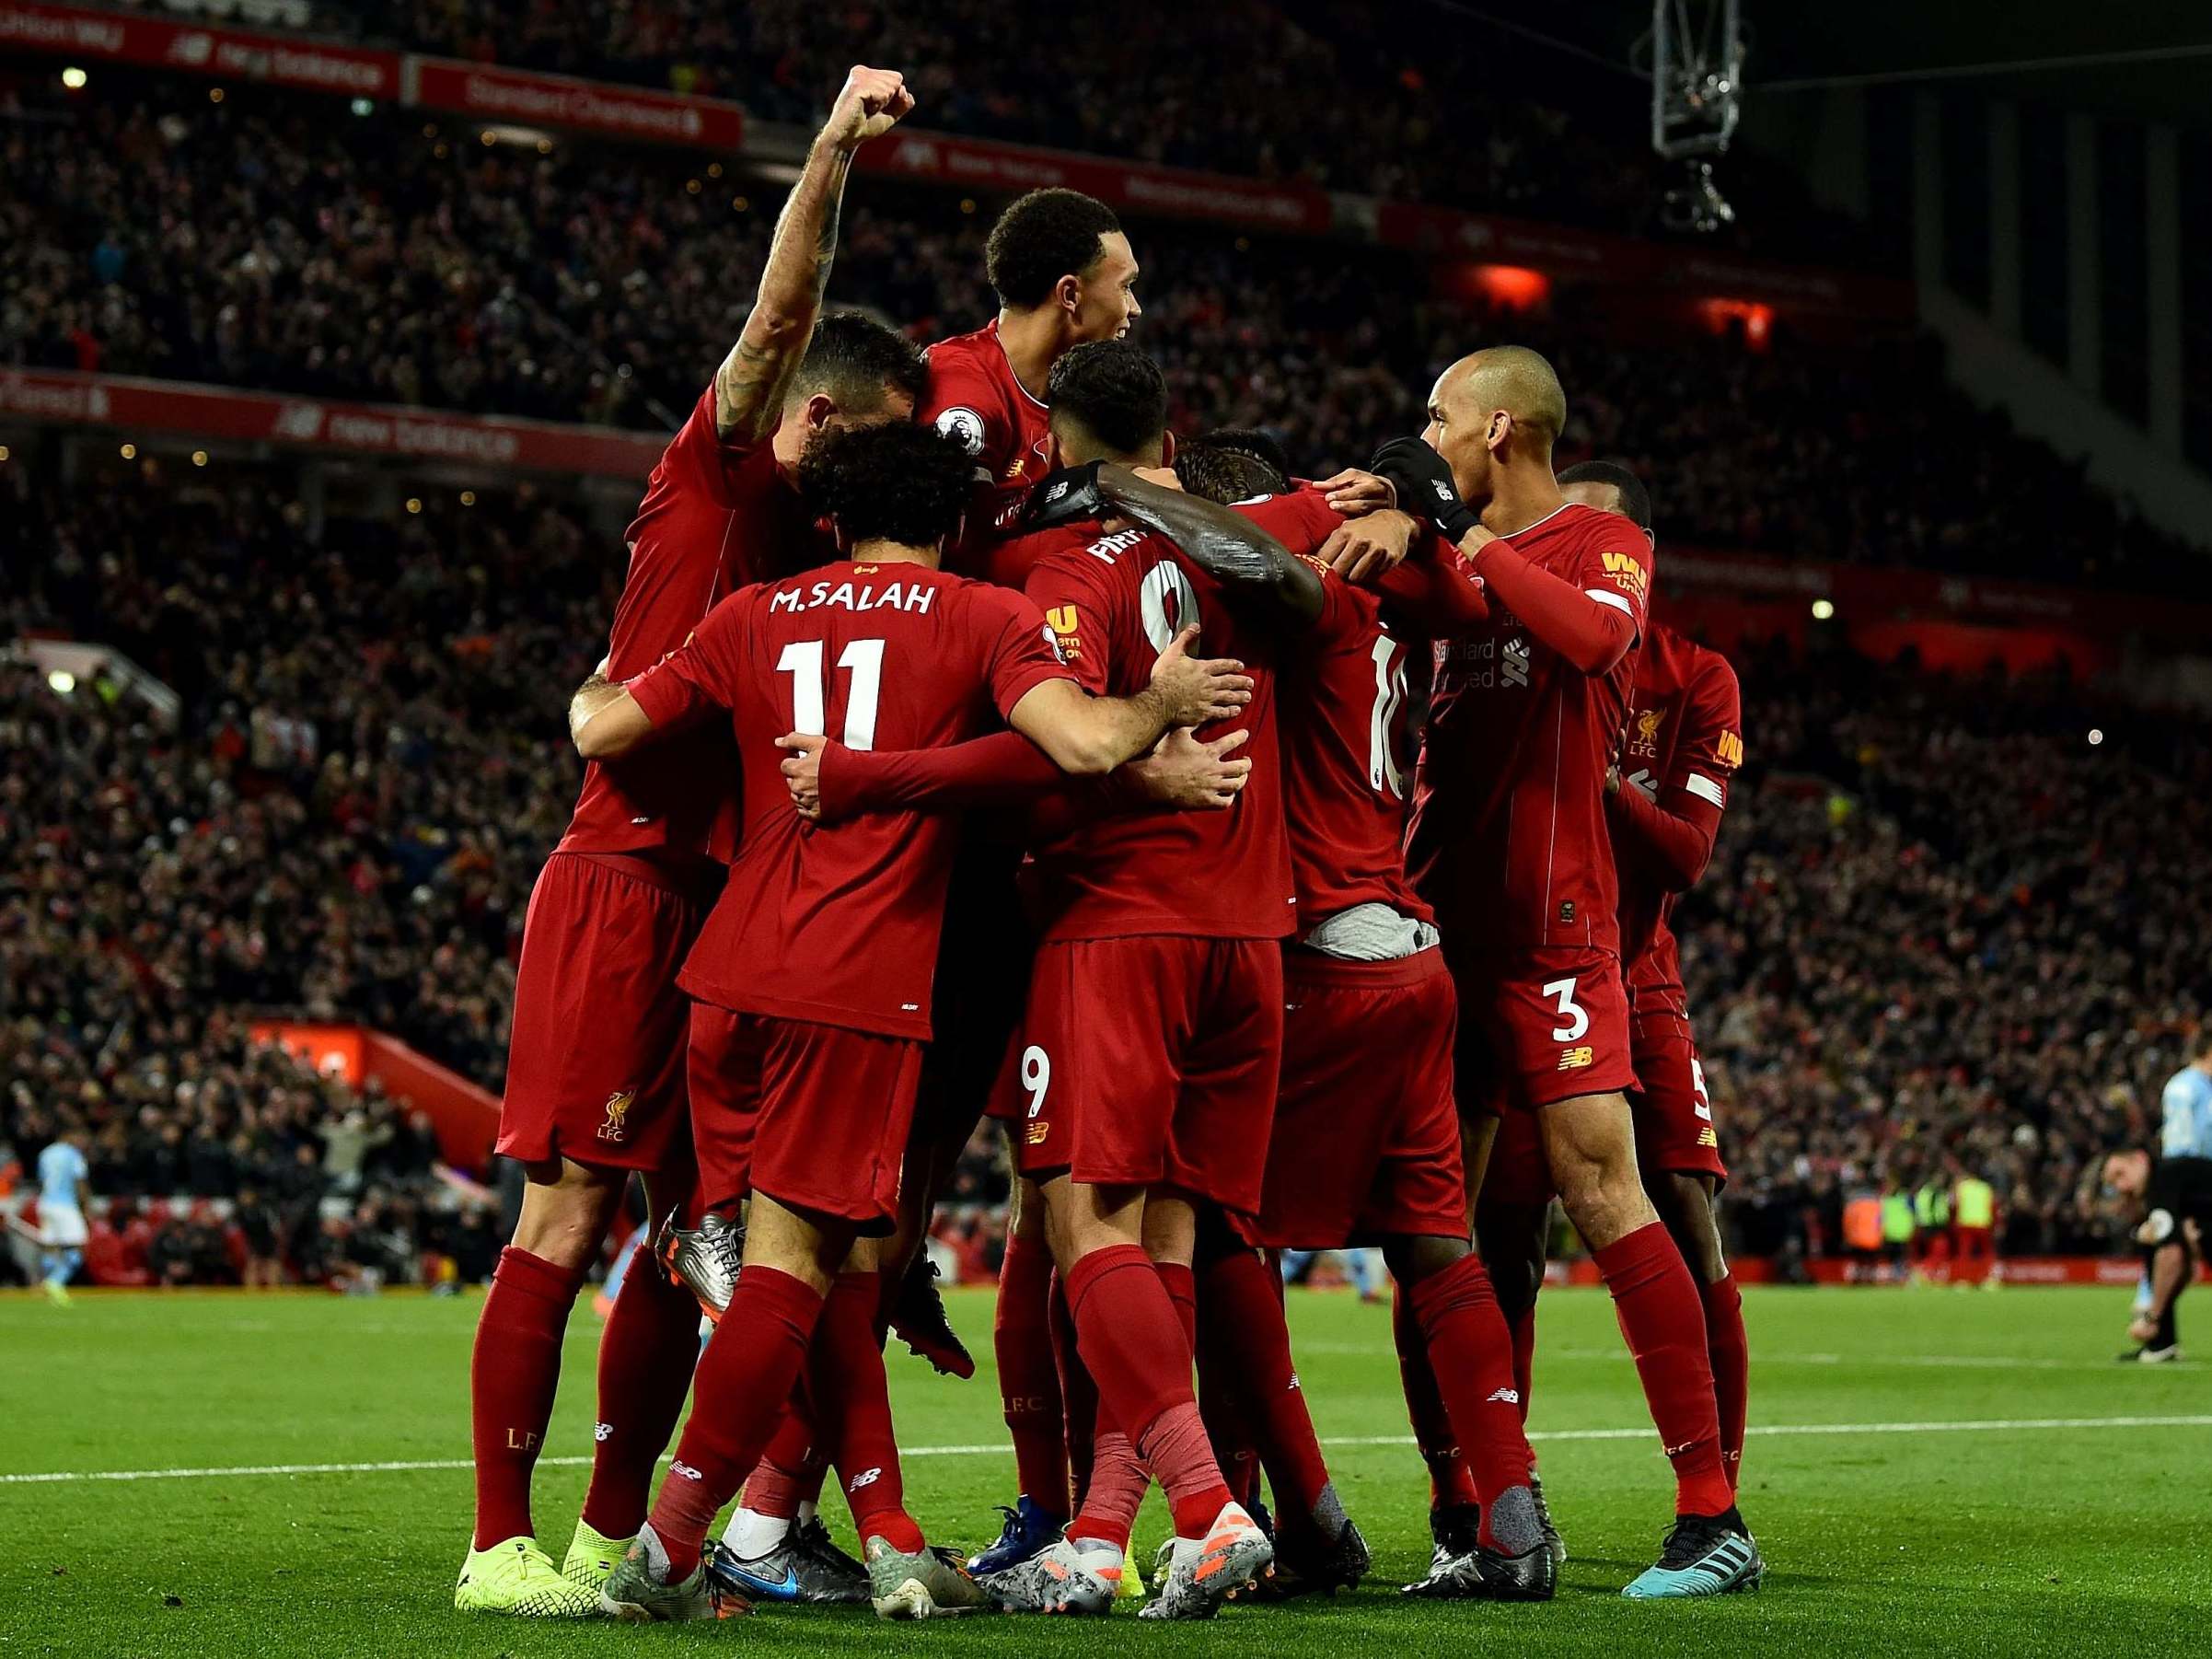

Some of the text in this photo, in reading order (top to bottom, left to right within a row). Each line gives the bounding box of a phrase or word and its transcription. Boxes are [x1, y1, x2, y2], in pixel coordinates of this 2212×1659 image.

[770, 582, 935, 614] M.SALAH
[776, 639, 886, 755] 11
[1543, 977, 1590, 1042] 3
[1021, 1045, 1050, 1119] 9
[597, 1128, 624, 1142] LFC
